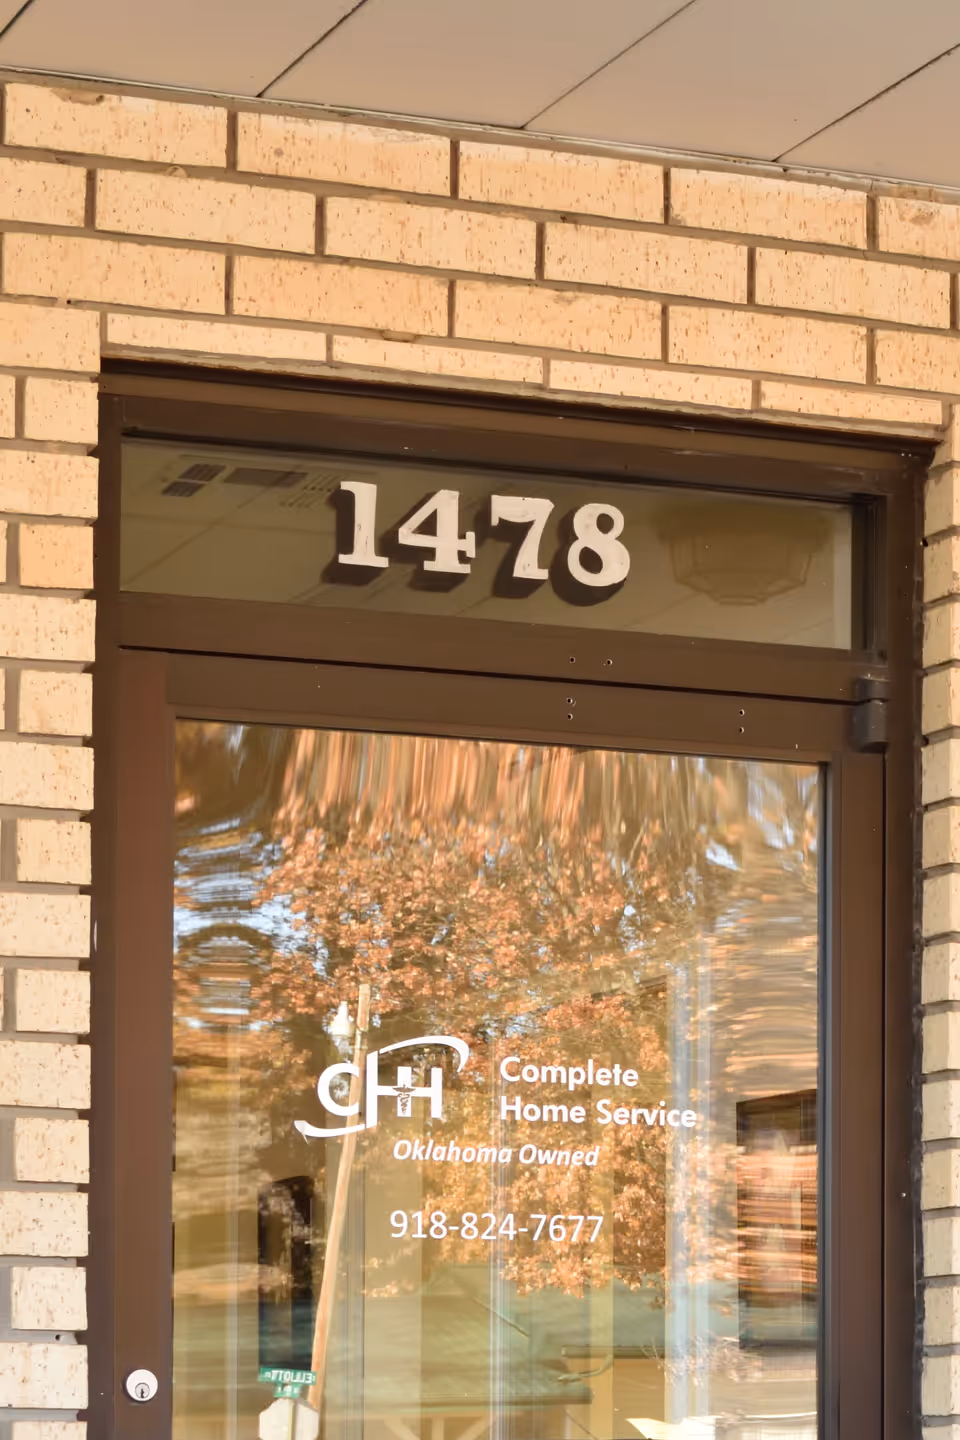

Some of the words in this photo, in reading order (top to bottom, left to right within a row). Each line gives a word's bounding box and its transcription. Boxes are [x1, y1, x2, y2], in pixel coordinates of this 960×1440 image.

[337, 480, 631, 588] 1478
[499, 1056, 639, 1091] Complete
[499, 1095, 586, 1124] Home
[596, 1099, 698, 1128] Service
[392, 1139, 512, 1164] Oklahoma
[518, 1144, 600, 1167] Owned
[389, 1210, 604, 1243] 918-824-7677
